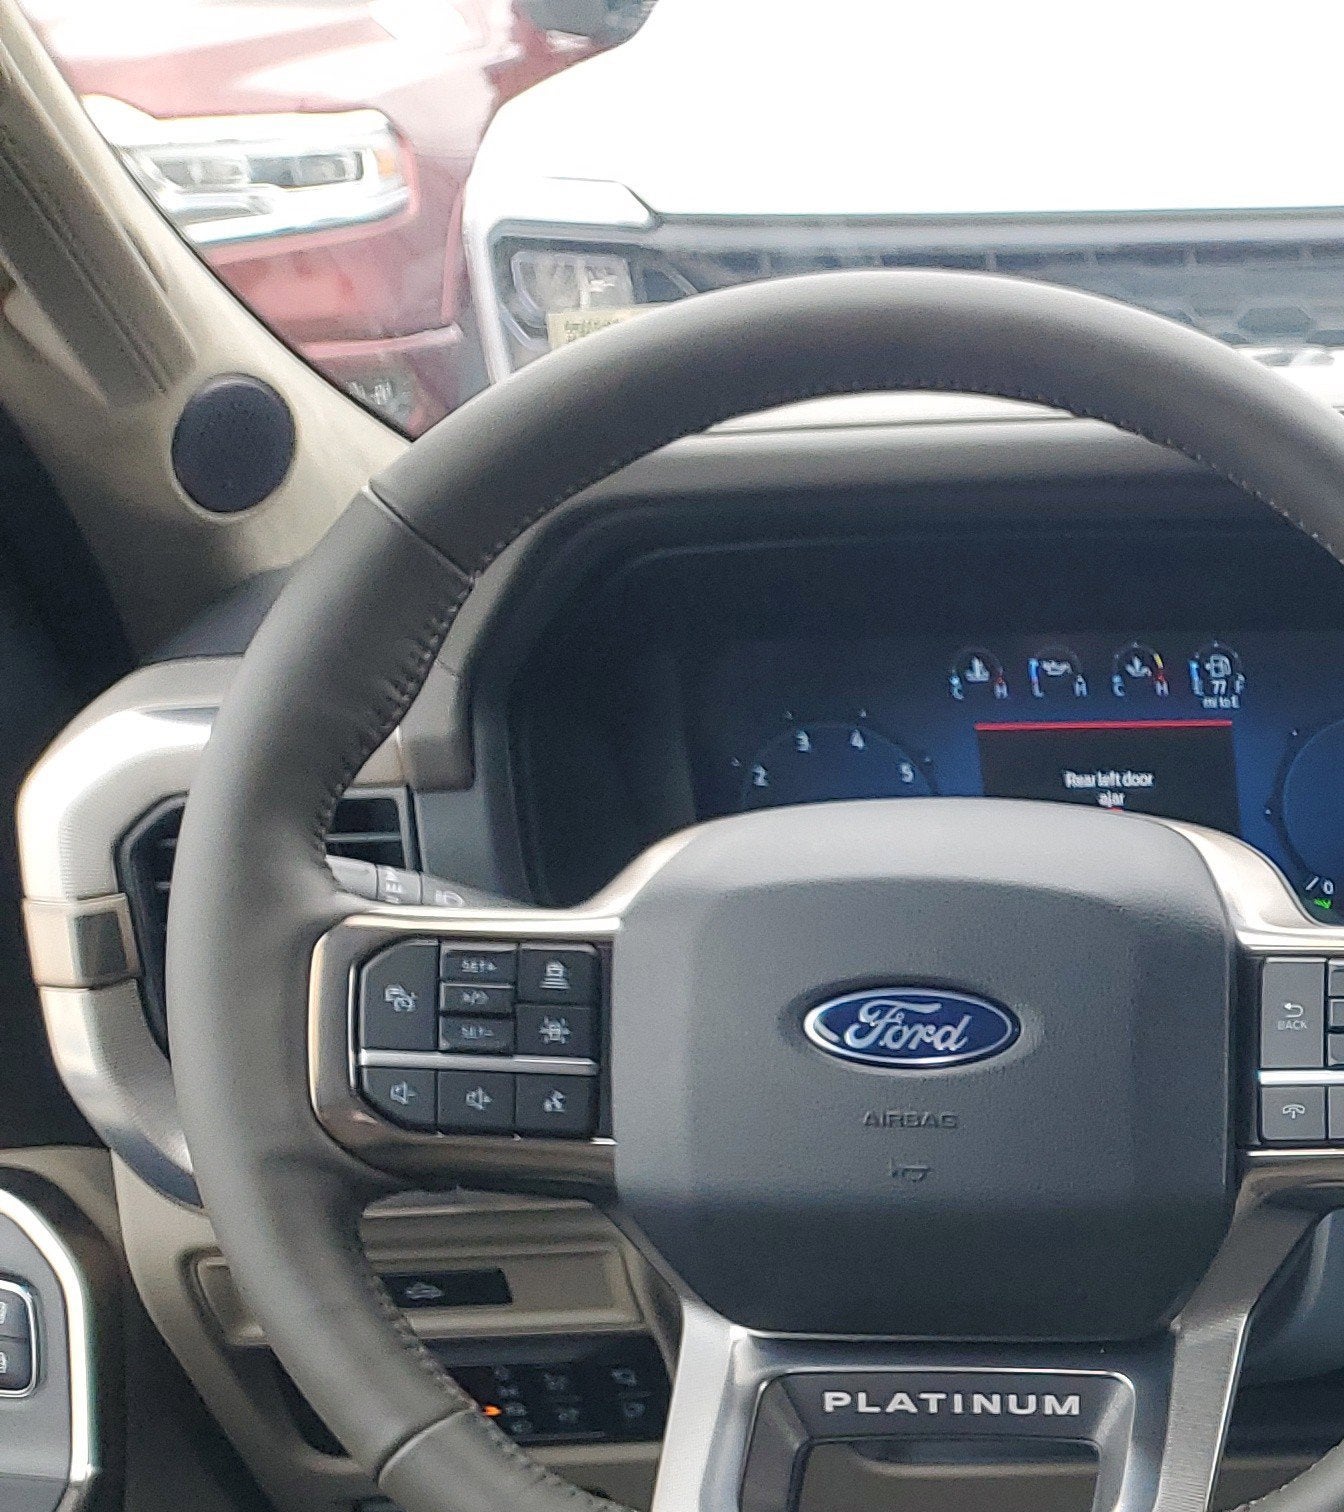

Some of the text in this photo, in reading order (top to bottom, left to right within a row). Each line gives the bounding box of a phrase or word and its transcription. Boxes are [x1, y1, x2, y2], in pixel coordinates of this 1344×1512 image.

[1323, 880, 1334, 894] 0
[844, 998, 970, 1051] Ford
[1277, 1020, 1307, 1030] BACK
[862, 1110, 959, 1129] AIRBAG
[822, 1391, 1081, 1416] PLATINUM
